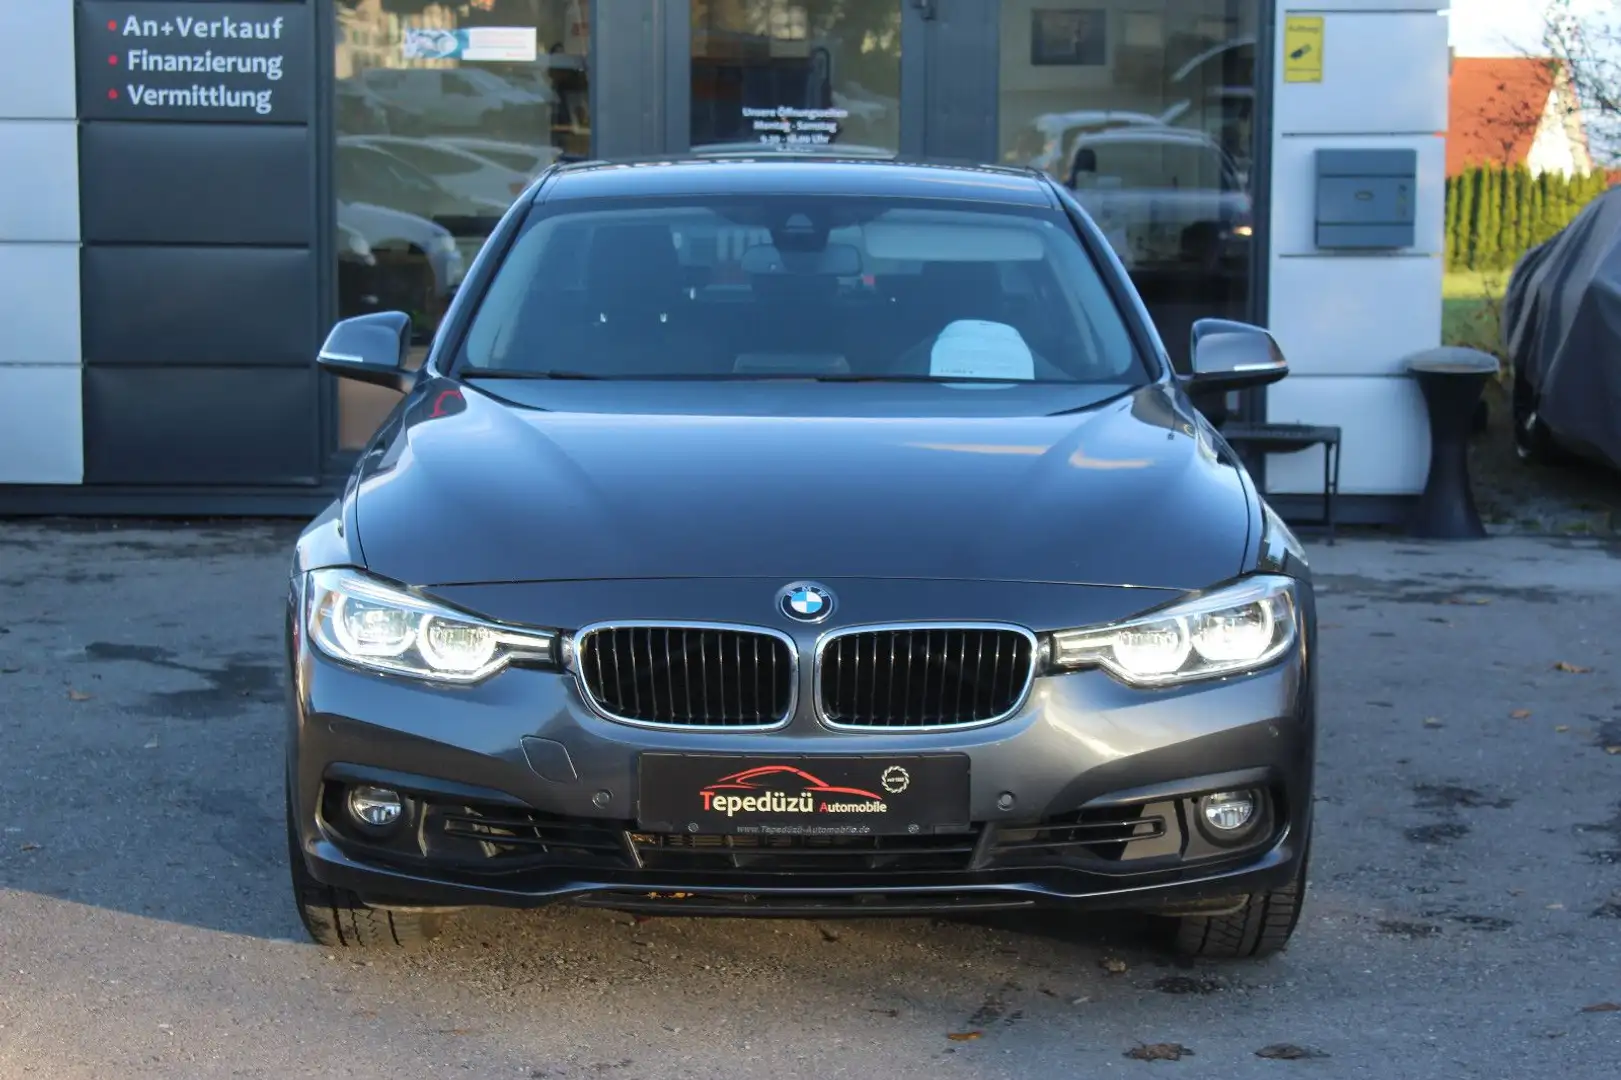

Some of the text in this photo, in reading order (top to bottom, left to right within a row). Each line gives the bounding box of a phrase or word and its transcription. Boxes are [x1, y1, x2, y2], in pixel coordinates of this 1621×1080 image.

[122, 14, 284, 39] An+Verkauf
[127, 49, 283, 80] Finanzierung
[127, 84, 273, 114] Vermittlung
[700, 791, 887, 816] Tepedüzü Automobile
